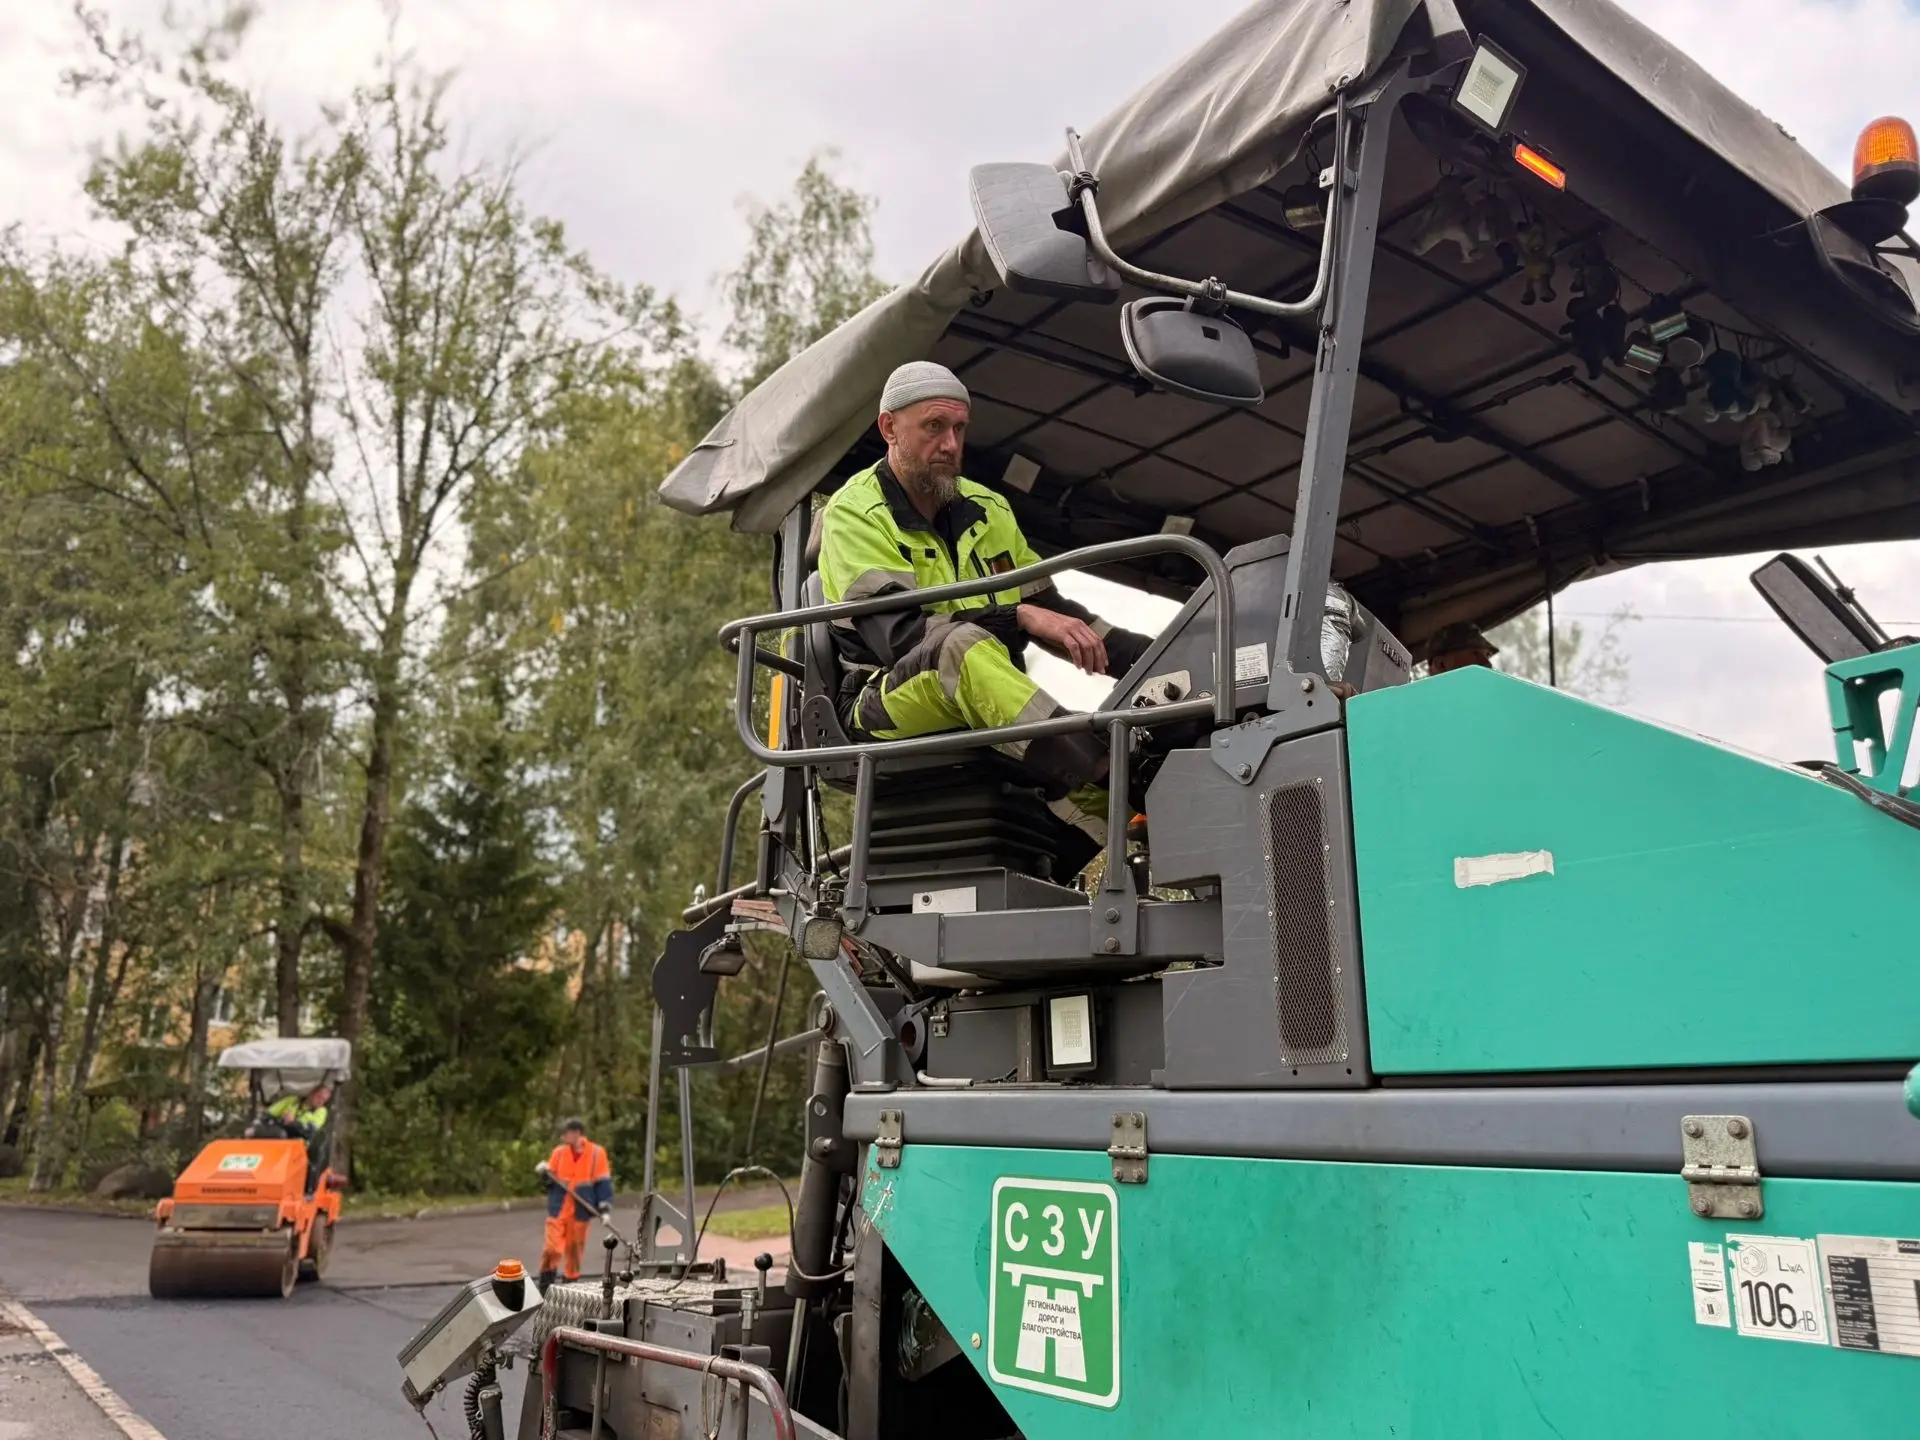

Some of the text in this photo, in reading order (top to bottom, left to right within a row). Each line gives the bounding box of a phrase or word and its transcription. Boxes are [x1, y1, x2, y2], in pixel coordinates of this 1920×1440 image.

[1027, 1299, 1076, 1314] РЕГИОНАЛЬНЫХ
[1740, 1279, 1797, 1330] 106
[1038, 1313, 1065, 1325] ДОРОГ И
[1022, 1322, 1081, 1340] БЛАГОУСТРОЙСТВА
